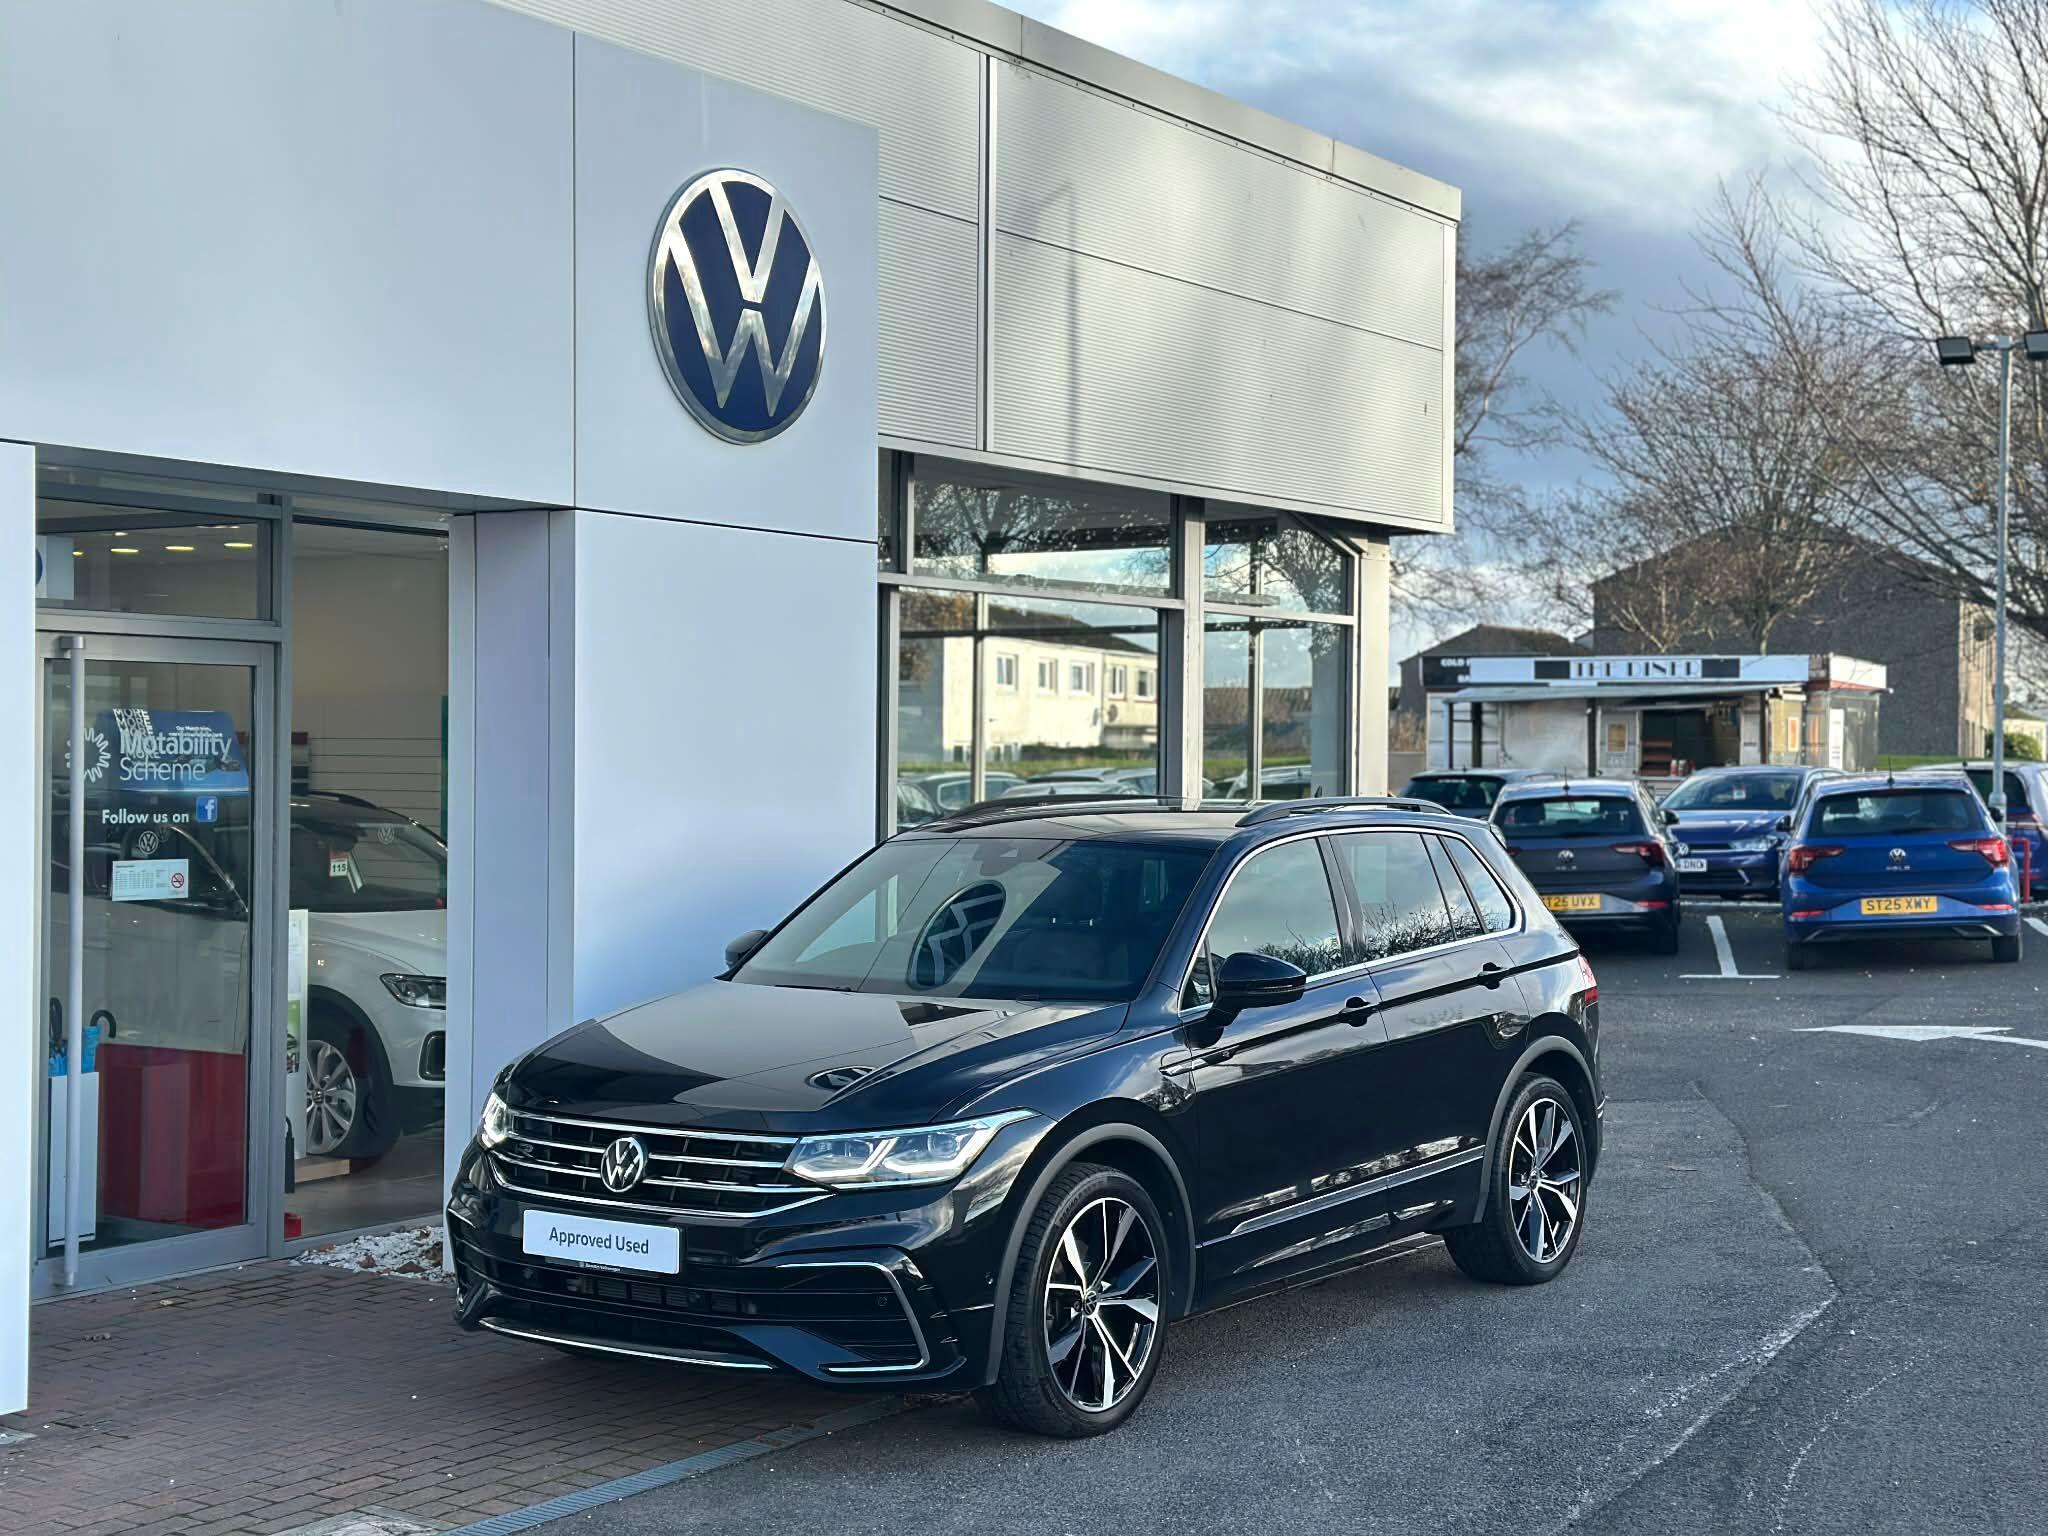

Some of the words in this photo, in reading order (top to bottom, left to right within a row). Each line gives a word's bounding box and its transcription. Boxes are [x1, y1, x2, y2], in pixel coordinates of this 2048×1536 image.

[119, 730, 231, 763] Motability
[119, 756, 206, 781] Scheme
[101, 808, 150, 824] Follow
[153, 813, 168, 824] us
[172, 813, 190, 823] on
[332, 863, 347, 872] 115
[1571, 895, 1595, 907] UVX
[1866, 899, 1902, 912] ST25
[549, 1226, 612, 1249] Approved
[615, 1235, 649, 1255] Used
